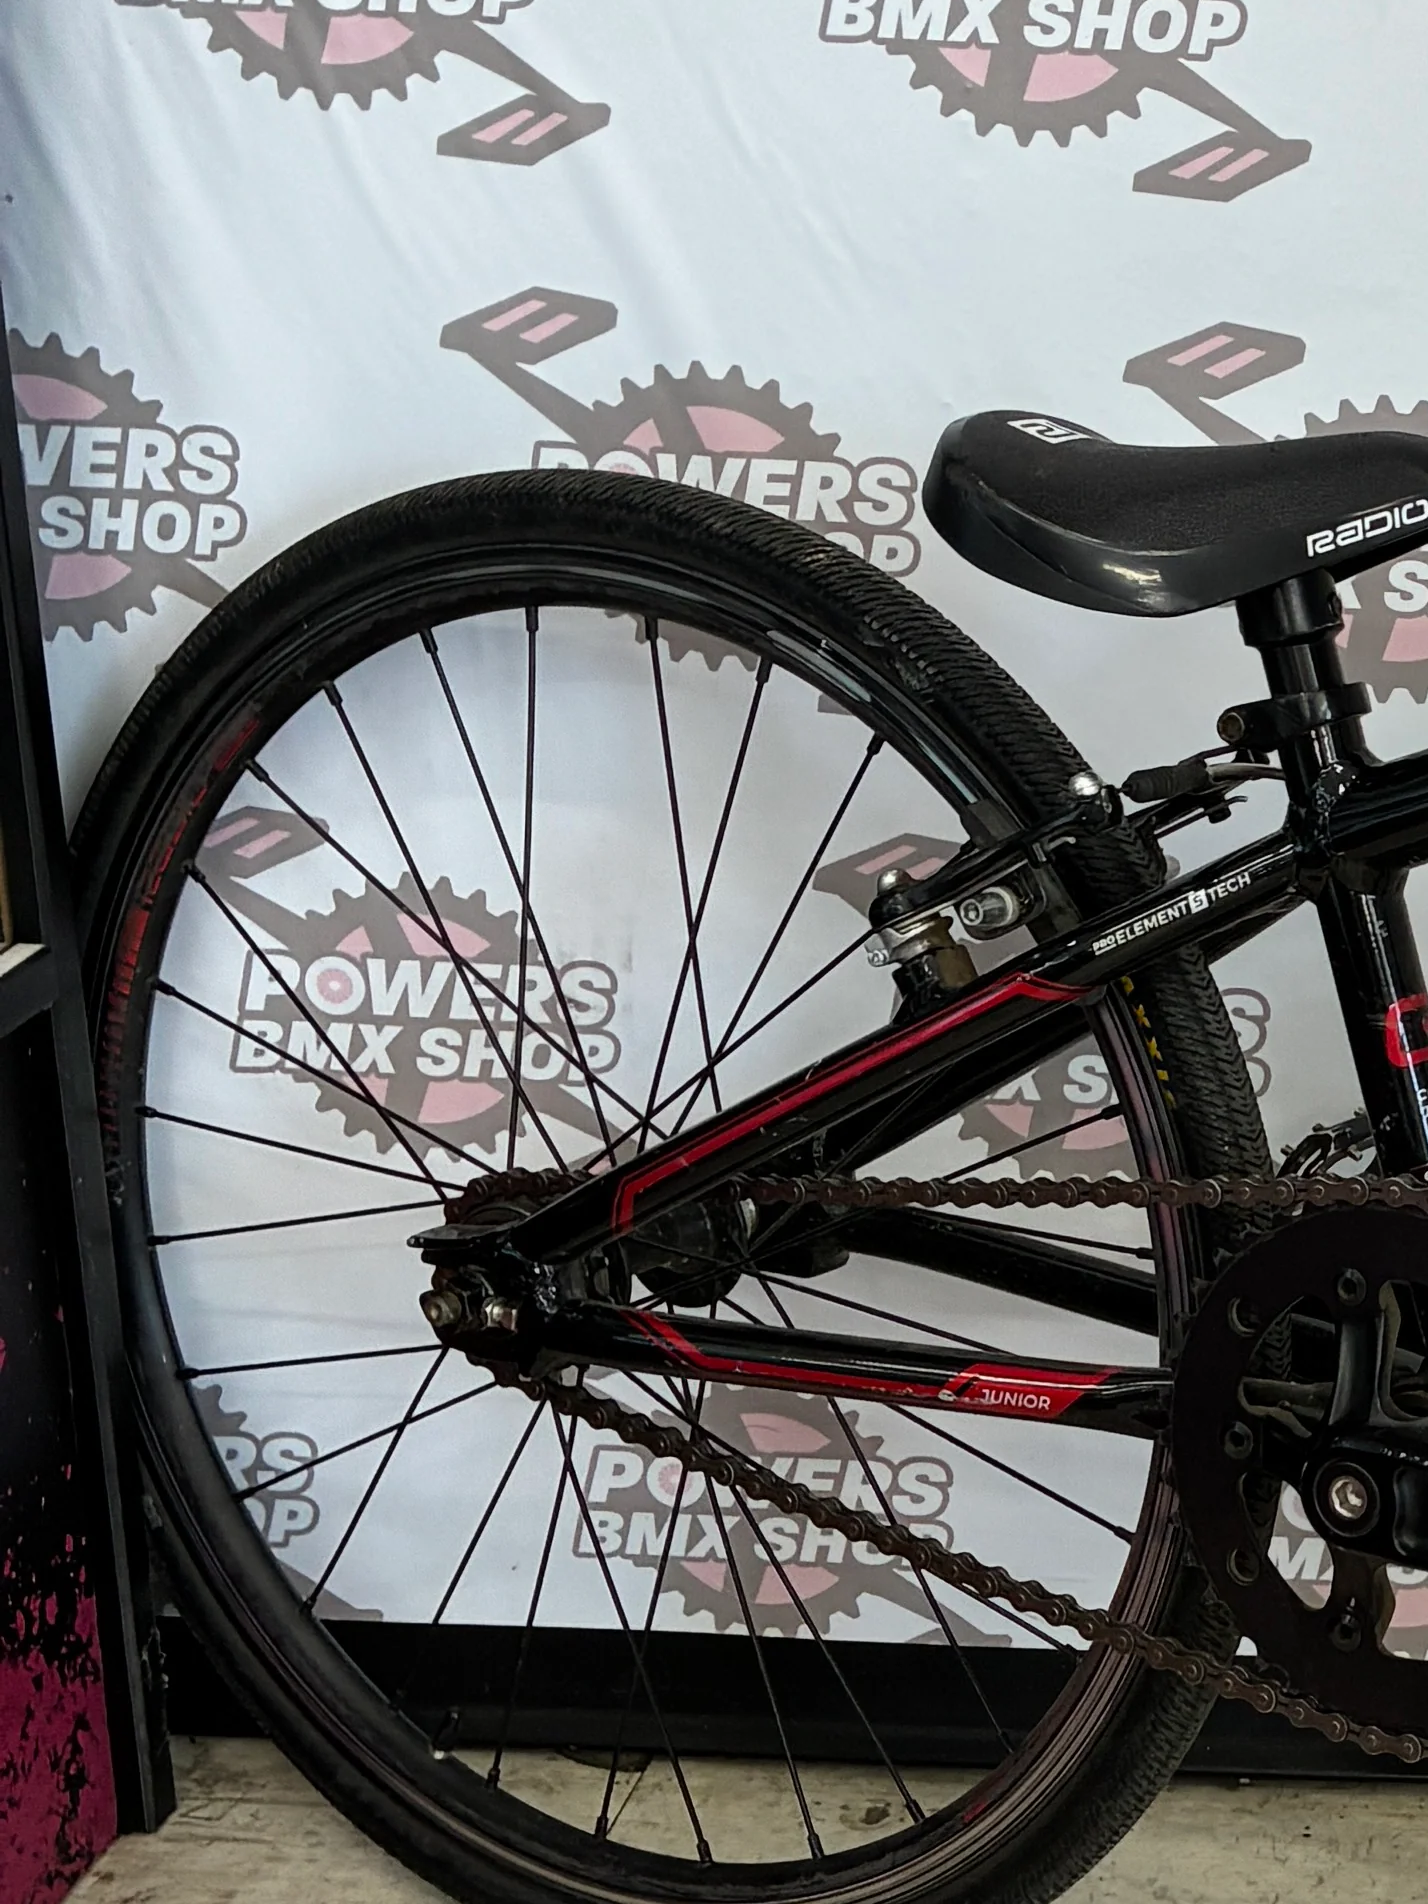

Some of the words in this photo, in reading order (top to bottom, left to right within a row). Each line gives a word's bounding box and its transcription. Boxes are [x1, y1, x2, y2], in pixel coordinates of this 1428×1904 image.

[20, 424, 238, 495] WERS
[39, 498, 240, 555] SHOP
[1115, 899, 1189, 945] ELEMENT
[1206, 871, 1251, 902] TECH
[242, 956, 614, 1026] POWERS
[234, 1021, 401, 1074] BMX
[417, 1027, 619, 1083] SHOP
[978, 1388, 1051, 1411] JUNIOR
[580, 1511, 729, 1559] BMX
